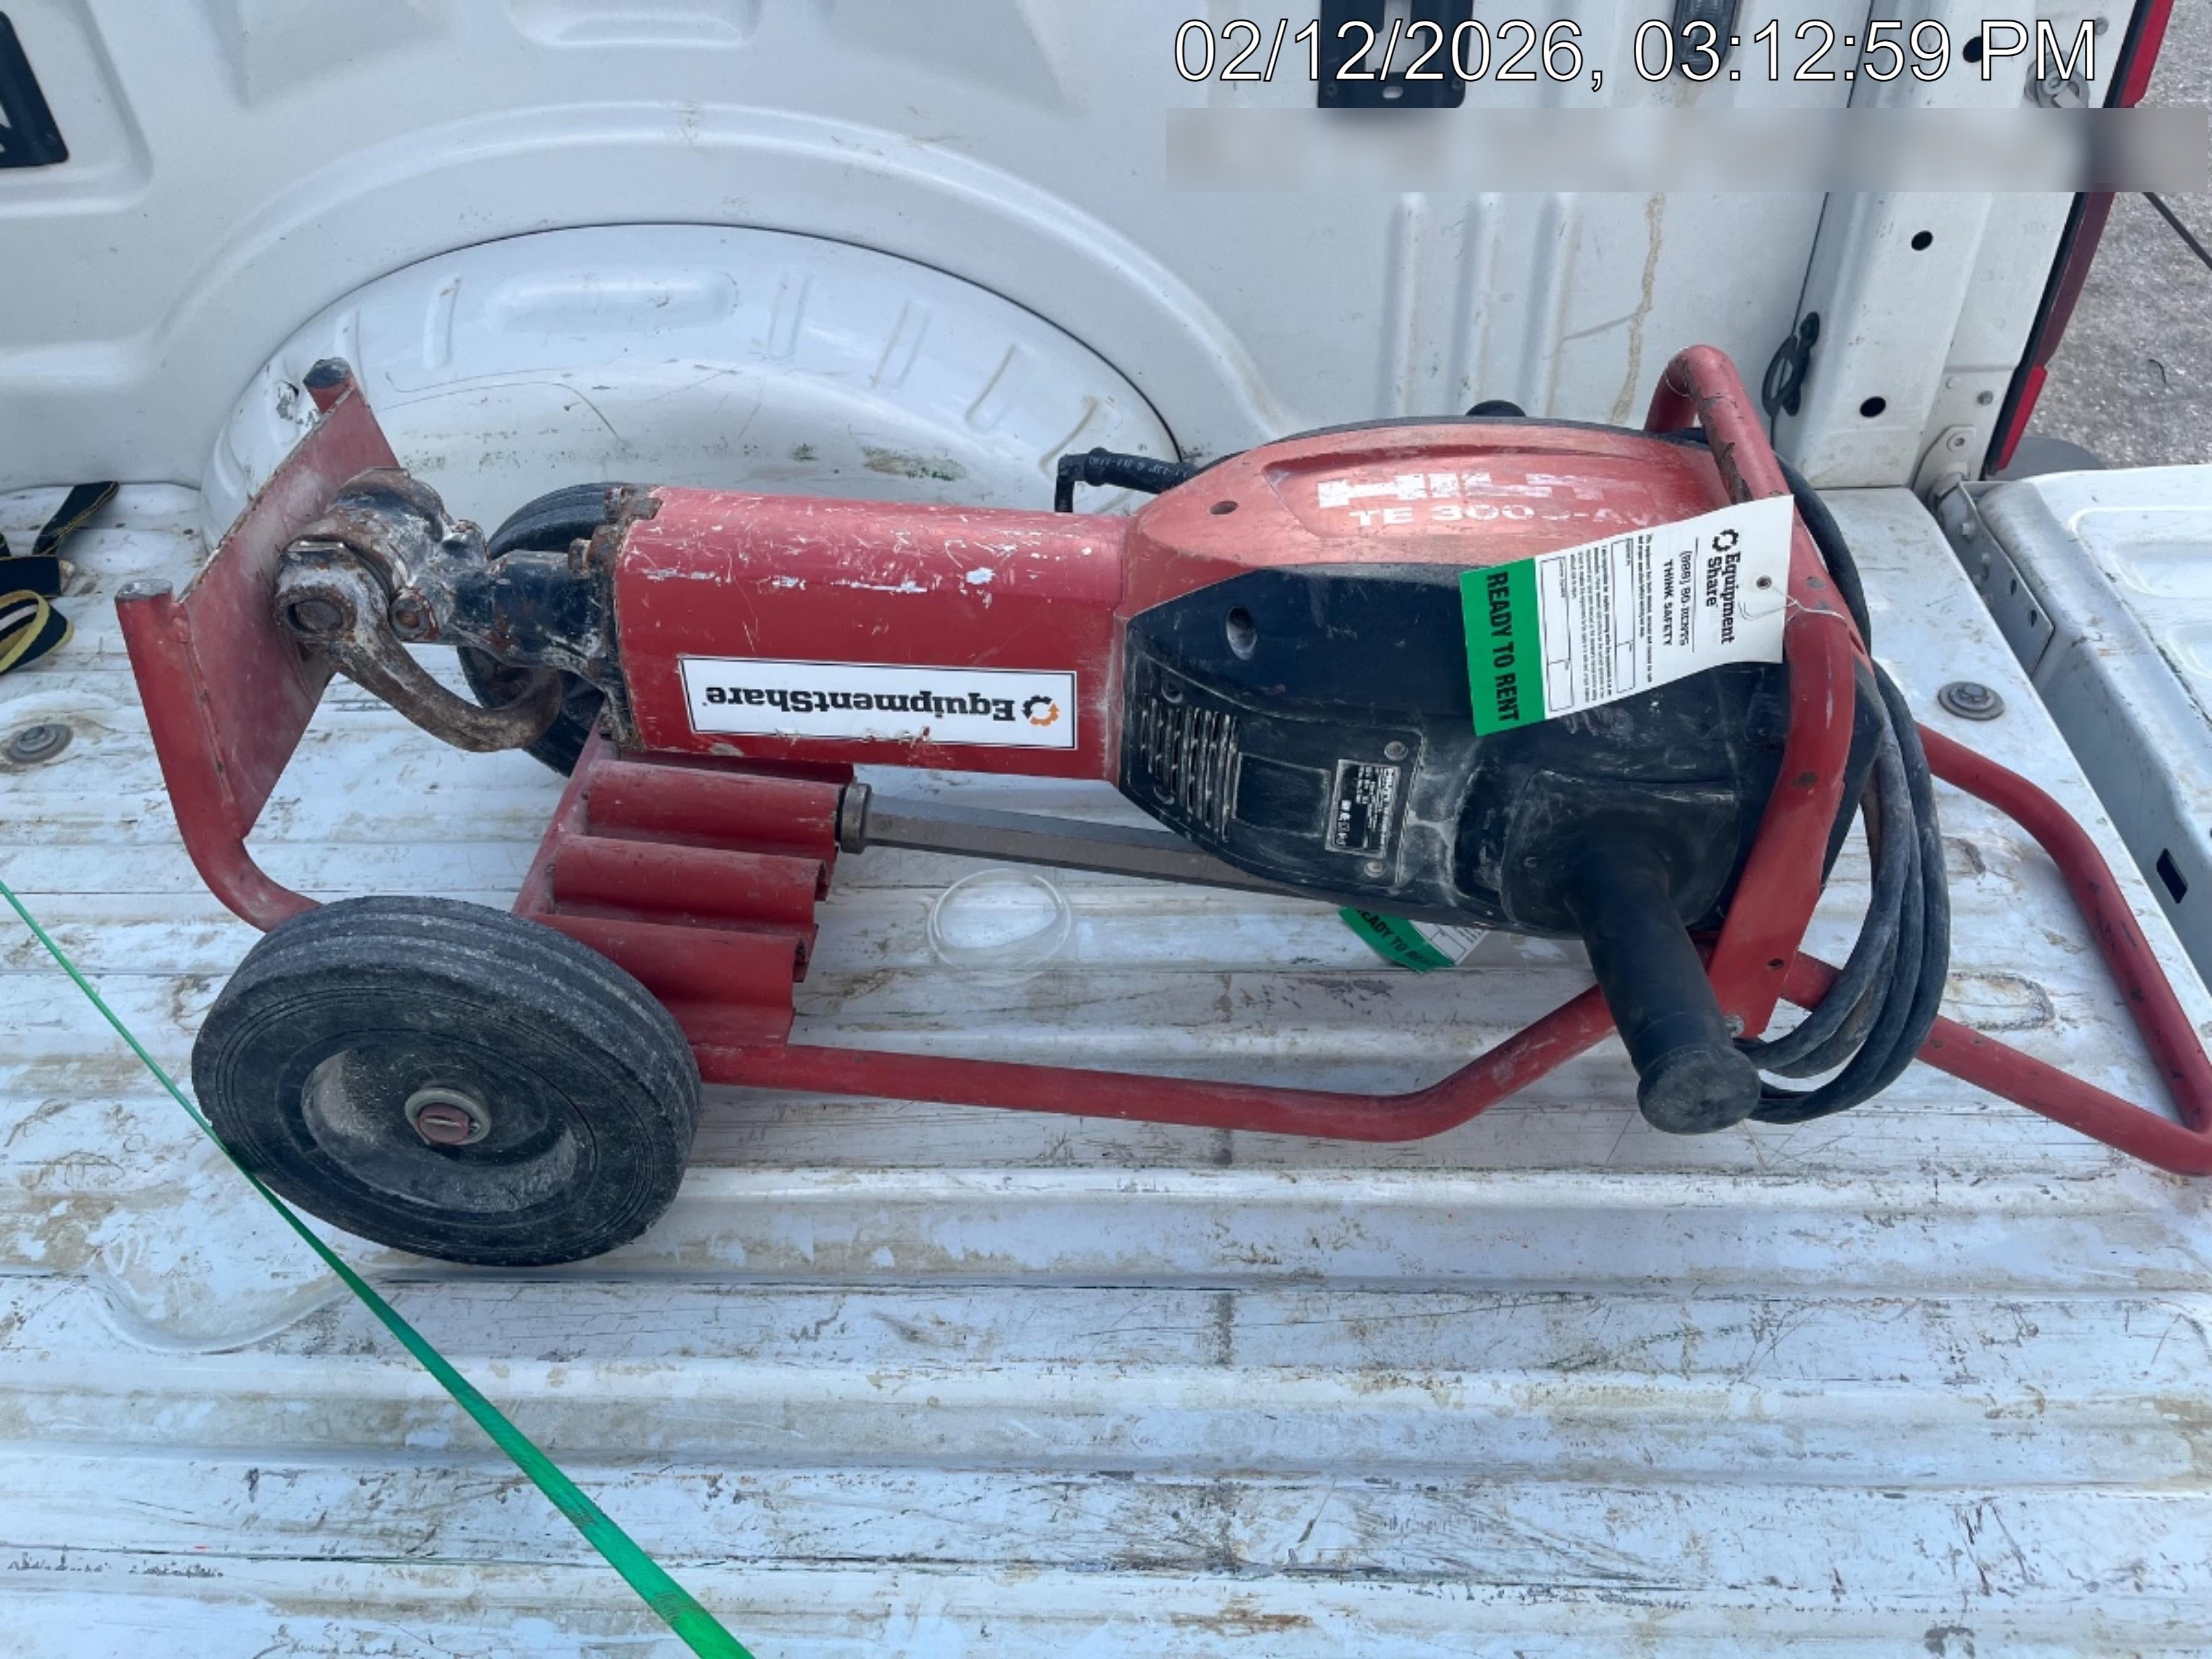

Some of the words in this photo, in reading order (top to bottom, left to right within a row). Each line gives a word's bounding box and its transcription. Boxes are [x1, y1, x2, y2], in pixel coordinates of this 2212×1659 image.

[1317, 472, 1647, 508] HILT
[1350, 506, 1413, 527] TE
[1664, 559, 1674, 600] THINK
[1679, 551, 1692, 584] (888)
[1706, 556, 1722, 607] Share
[1486, 571, 1512, 637] READY
[1720, 551, 1741, 644] Equipment
[1663, 602, 1673, 646] SAFETY
[1492, 641, 1515, 668] TO
[704, 685, 1016, 721] EquipmentShare
[1495, 672, 1519, 721] RENT
[1357, 910, 1393, 938] EADY
[1390, 936, 1408, 952] TO
